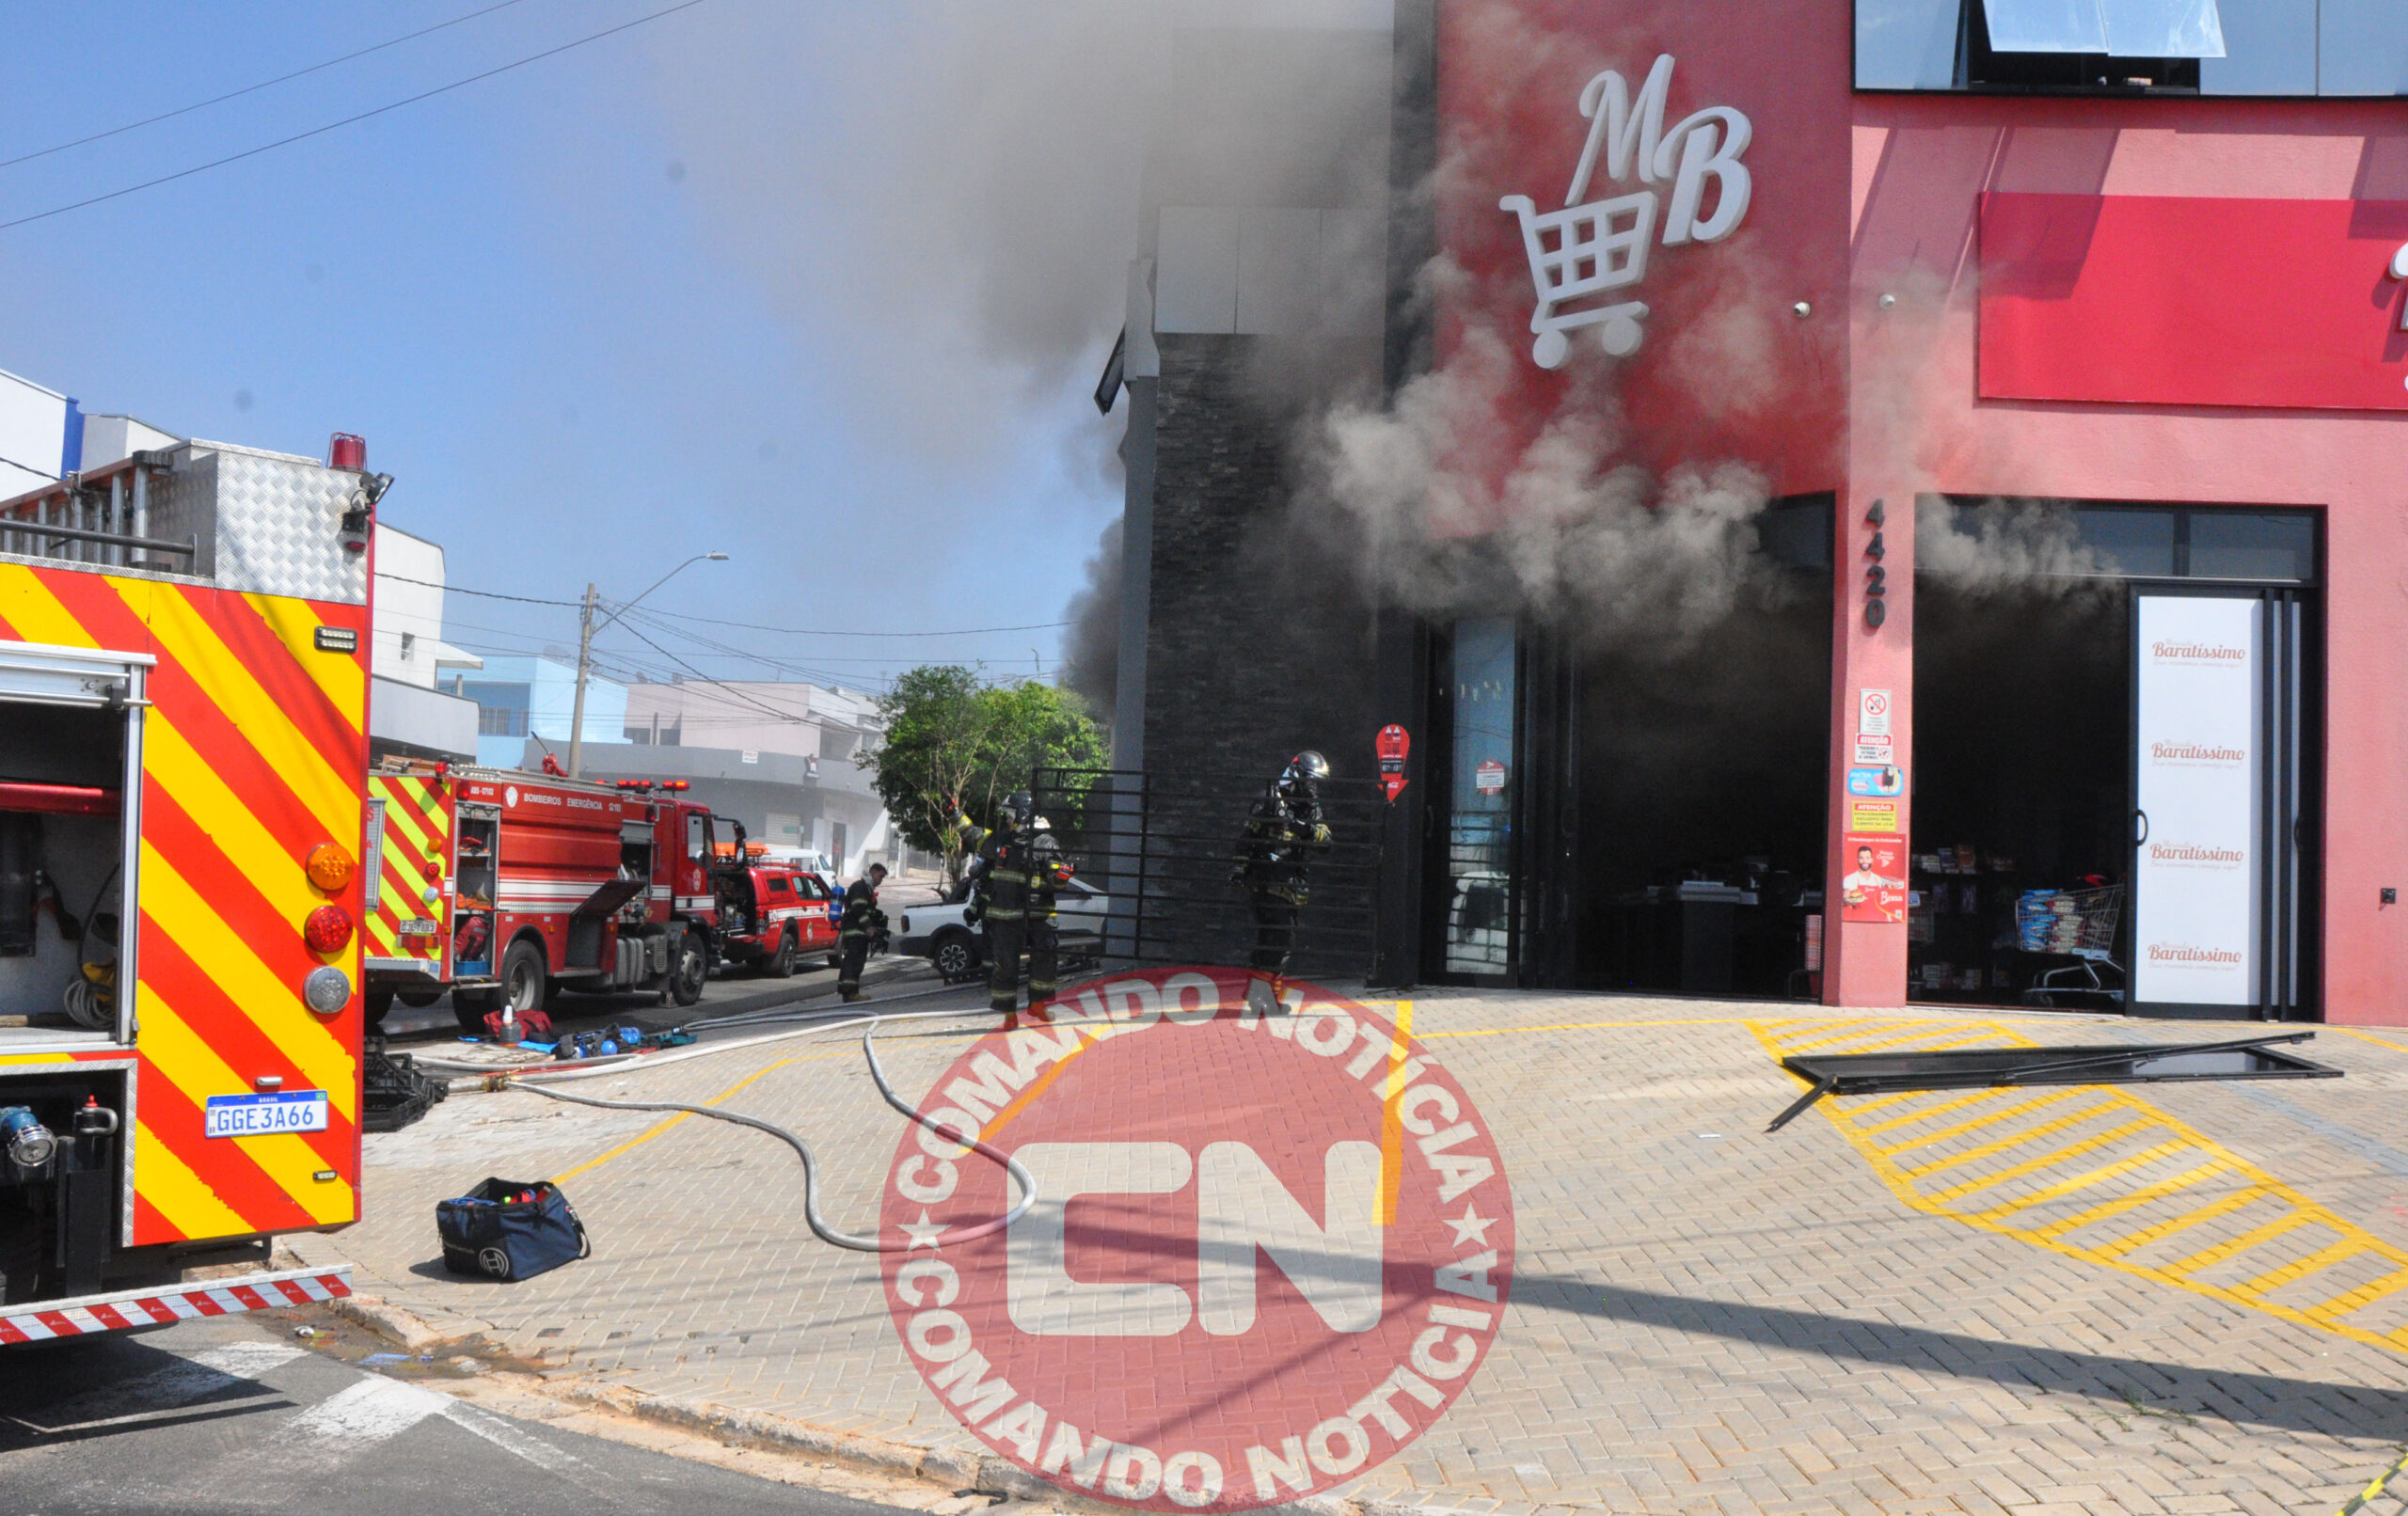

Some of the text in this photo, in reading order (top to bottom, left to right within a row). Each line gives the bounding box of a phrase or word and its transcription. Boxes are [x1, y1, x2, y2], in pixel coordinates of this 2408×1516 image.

[1564, 54, 1752, 246] MB
[1865, 498, 1886, 627] 4420
[2152, 641, 2245, 659] Baratíssimo
[2151, 742, 2244, 760] Baratíssimo
[524, 793, 562, 806] BOMBEIROS
[567, 797, 603, 811] EMERGÊNCIA
[2150, 843, 2243, 861] Baratíssimo
[2148, 944, 2242, 963] Baratíssimo
[217, 1104, 313, 1131] GGE3A66
